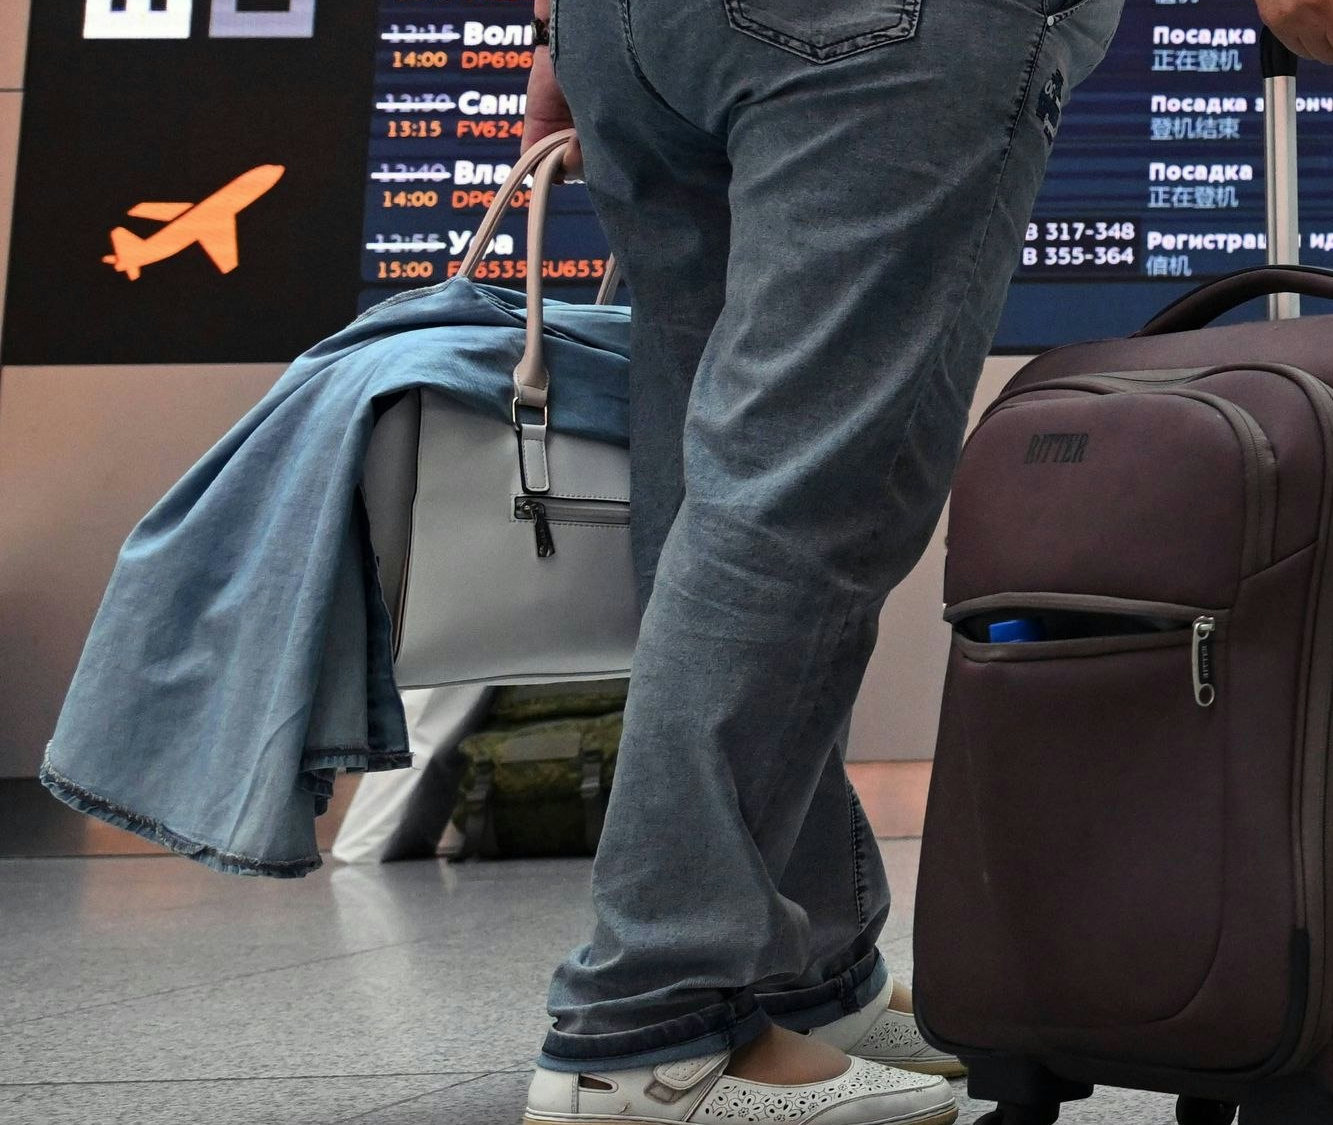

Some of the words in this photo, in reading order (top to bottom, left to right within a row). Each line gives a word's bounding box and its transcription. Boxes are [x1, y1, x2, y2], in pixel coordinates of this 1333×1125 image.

[1153, 26, 1256, 46] Посадка
[1152, 49, 1242, 72] 正在登机
[1025, 223, 1038, 240] B
[1046, 222, 1135, 240] 317-348
[379, 262, 433, 278] 15:00
[1024, 433, 1088, 464] RITTER
